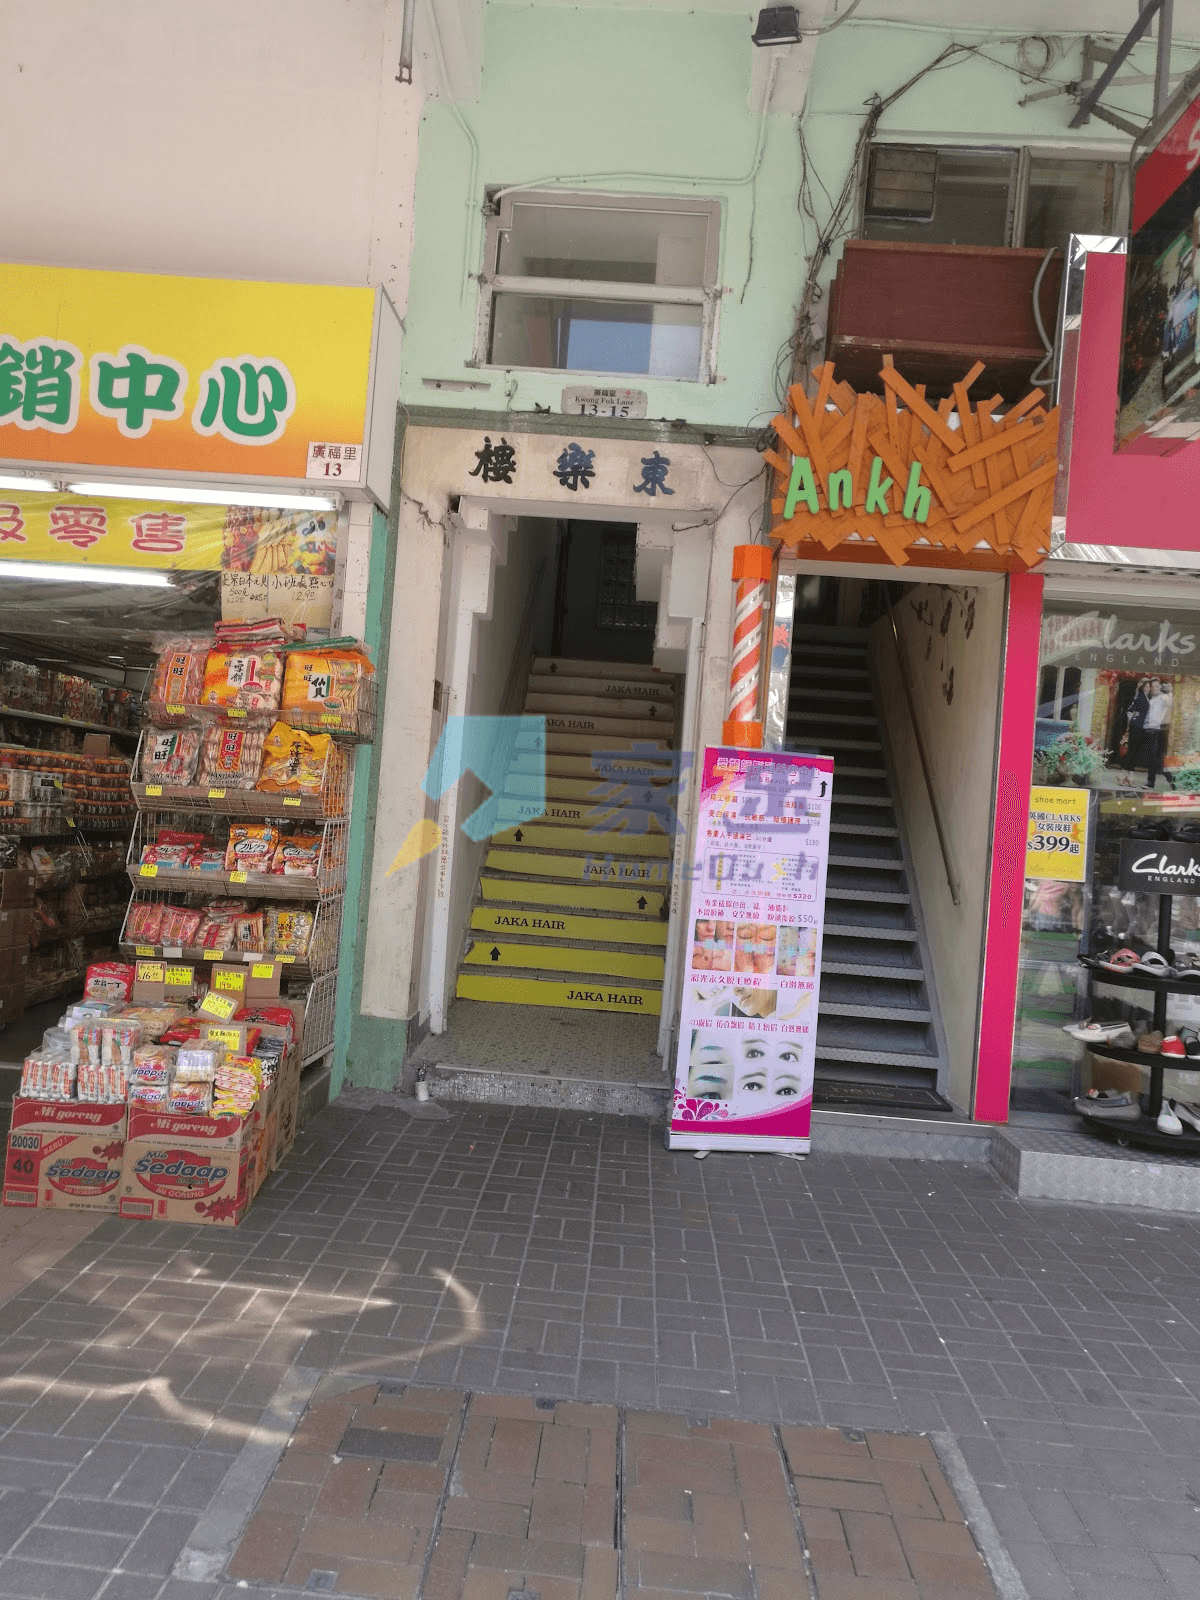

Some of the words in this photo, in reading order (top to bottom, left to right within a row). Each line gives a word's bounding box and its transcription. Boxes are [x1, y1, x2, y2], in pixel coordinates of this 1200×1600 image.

[0, 340, 290, 439] 銷中心
[575, 396, 599, 404] Kwong
[601, 397, 615, 405] Fuk
[617, 398, 635, 406] Lane
[580, 403, 630, 418] 13-15
[311, 444, 357, 461] 廣福里
[322, 462, 343, 478] 13
[783, 455, 932, 525] Ankh
[1054, 610, 1196, 655] Clarks
[1075, 653, 1179, 667] ENGLAND
[605, 684, 632, 695] JAKA
[633, 686, 660, 696] HAIR
[1035, 796, 1054, 804] shoe
[1056, 797, 1076, 805] mart
[518, 806, 548, 817] JAKA
[550, 808, 581, 819] HAIR
[1029, 811, 1081, 823] 英國CLARKS
[1038, 823, 1071, 833] 女裝皮鞋
[584, 865, 616, 876] JAKA
[618, 867, 651, 879] HAIR
[1147, 875, 1196, 885] ENGLAND
[495, 916, 529, 927] JAKA
[531, 918, 566, 930] HAIR
[567, 990, 604, 1003] JAKA
[606, 993, 644, 1006] HAIR
[56, 1110, 102, 1123] goreng
[171, 1121, 217, 1135] goreng
[11, 1135, 39, 1149] 20030
[13, 1158, 34, 1174] 40
[46, 1164, 121, 1181] Sedaap
[133, 1158, 230, 1182] Sedaap
